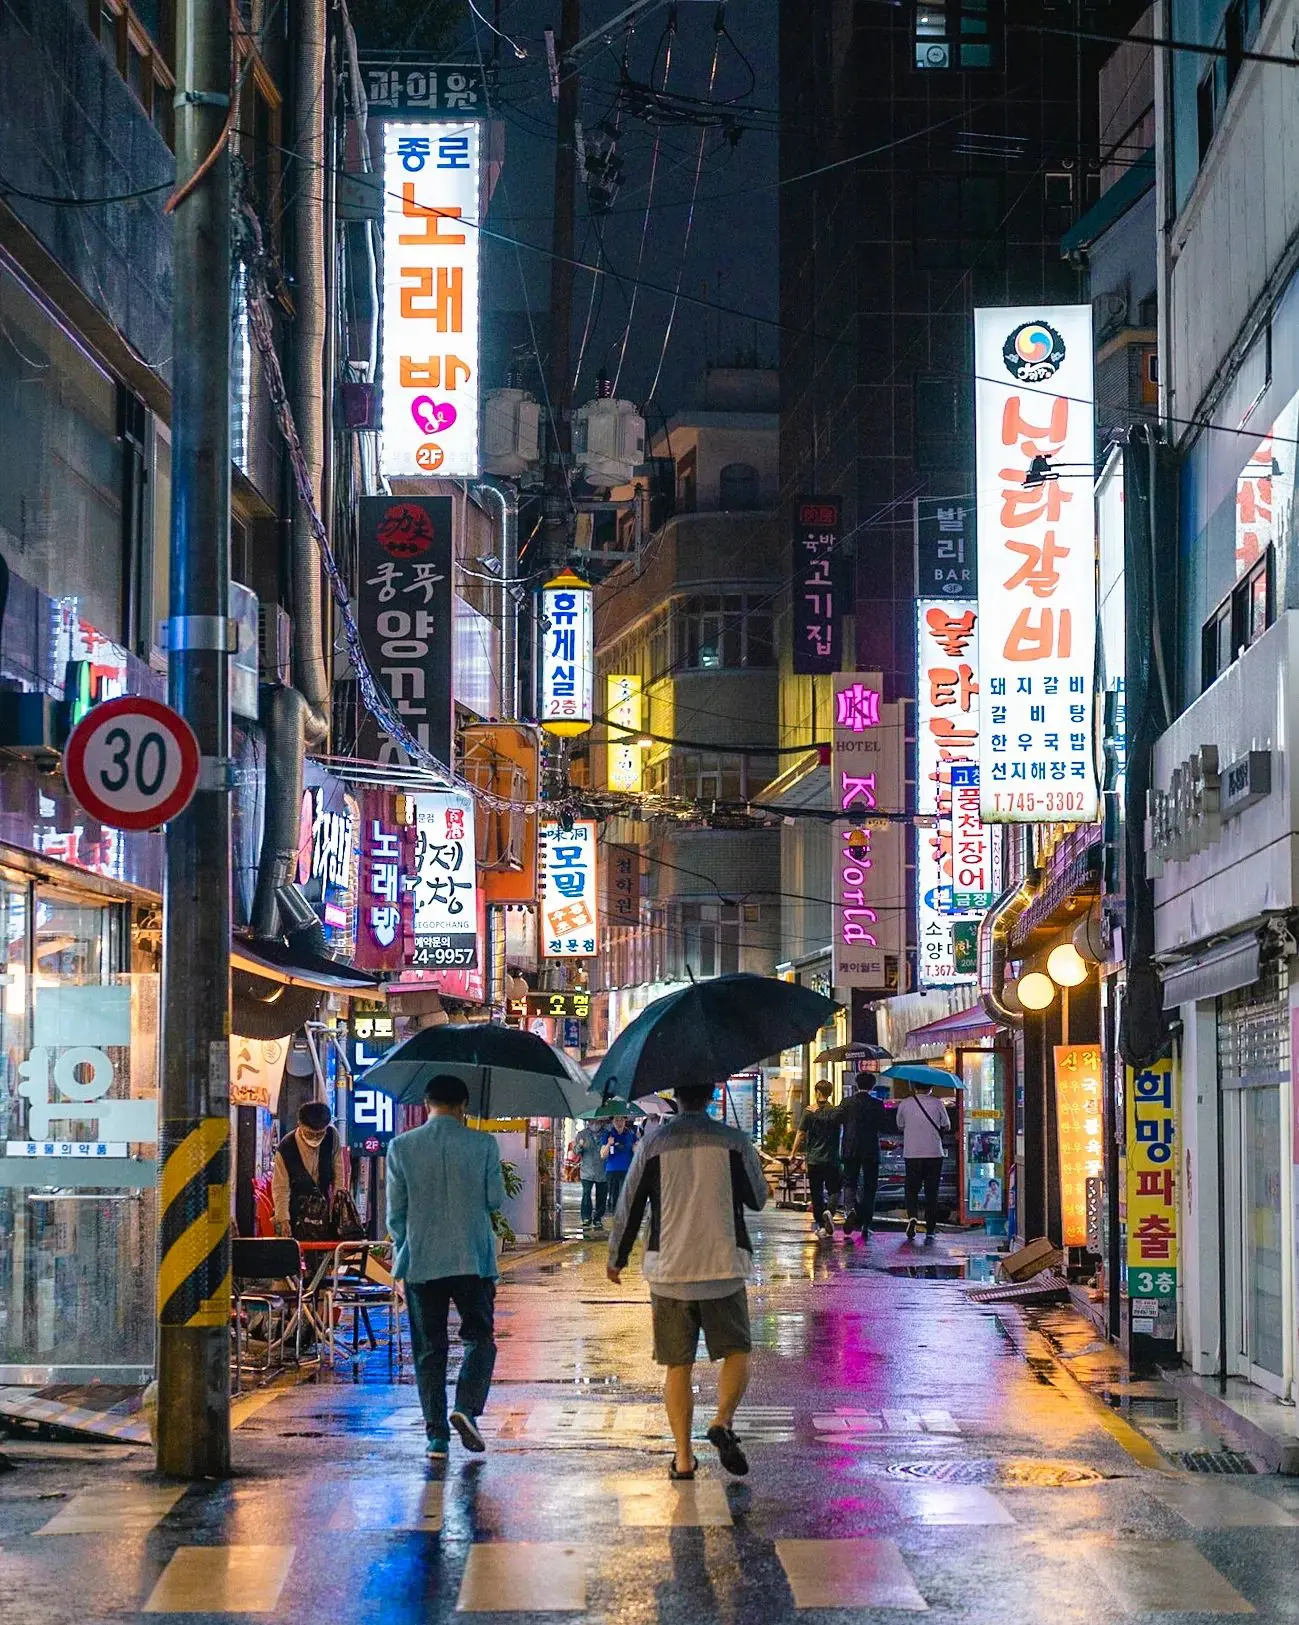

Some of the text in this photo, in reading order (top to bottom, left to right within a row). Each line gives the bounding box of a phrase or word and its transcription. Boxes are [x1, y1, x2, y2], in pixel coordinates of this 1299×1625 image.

[352, 71, 478, 110] 과의원
[398, 137, 470, 172] 종로
[399, 182, 471, 434] 노래방
[418, 448, 442, 465] 2F
[937, 507, 967, 563] 발리
[998, 396, 1072, 661] 신라갈비
[366, 562, 445, 604] 쿵푸
[934, 568, 971, 580] BAR
[804, 559, 833, 656] 고기집
[551, 593, 578, 697] 휴게실
[376, 610, 435, 771] 양꼬치
[990, 676, 1085, 695] 돼지갈비
[550, 699, 577, 716] 2층
[990, 704, 1086, 724] 갈비탕
[836, 740, 881, 752] HOTEL
[990, 733, 1086, 752] 한우국밥
[100, 728, 167, 796] 30
[990, 761, 1086, 781] 선지해장국
[994, 791, 1085, 813] T.745-3302
[958, 788, 987, 890] 풍천장어
[371, 818, 400, 947] 노래방
[548, 846, 588, 898] 모밀
[549, 938, 595, 953] 전문점
[838, 962, 882, 973] 케이월드
[365, 1140, 379, 1150] 2F
[1133, 1070, 1177, 1259] 희망파출
[1137, 1271, 1175, 1293] 3층
